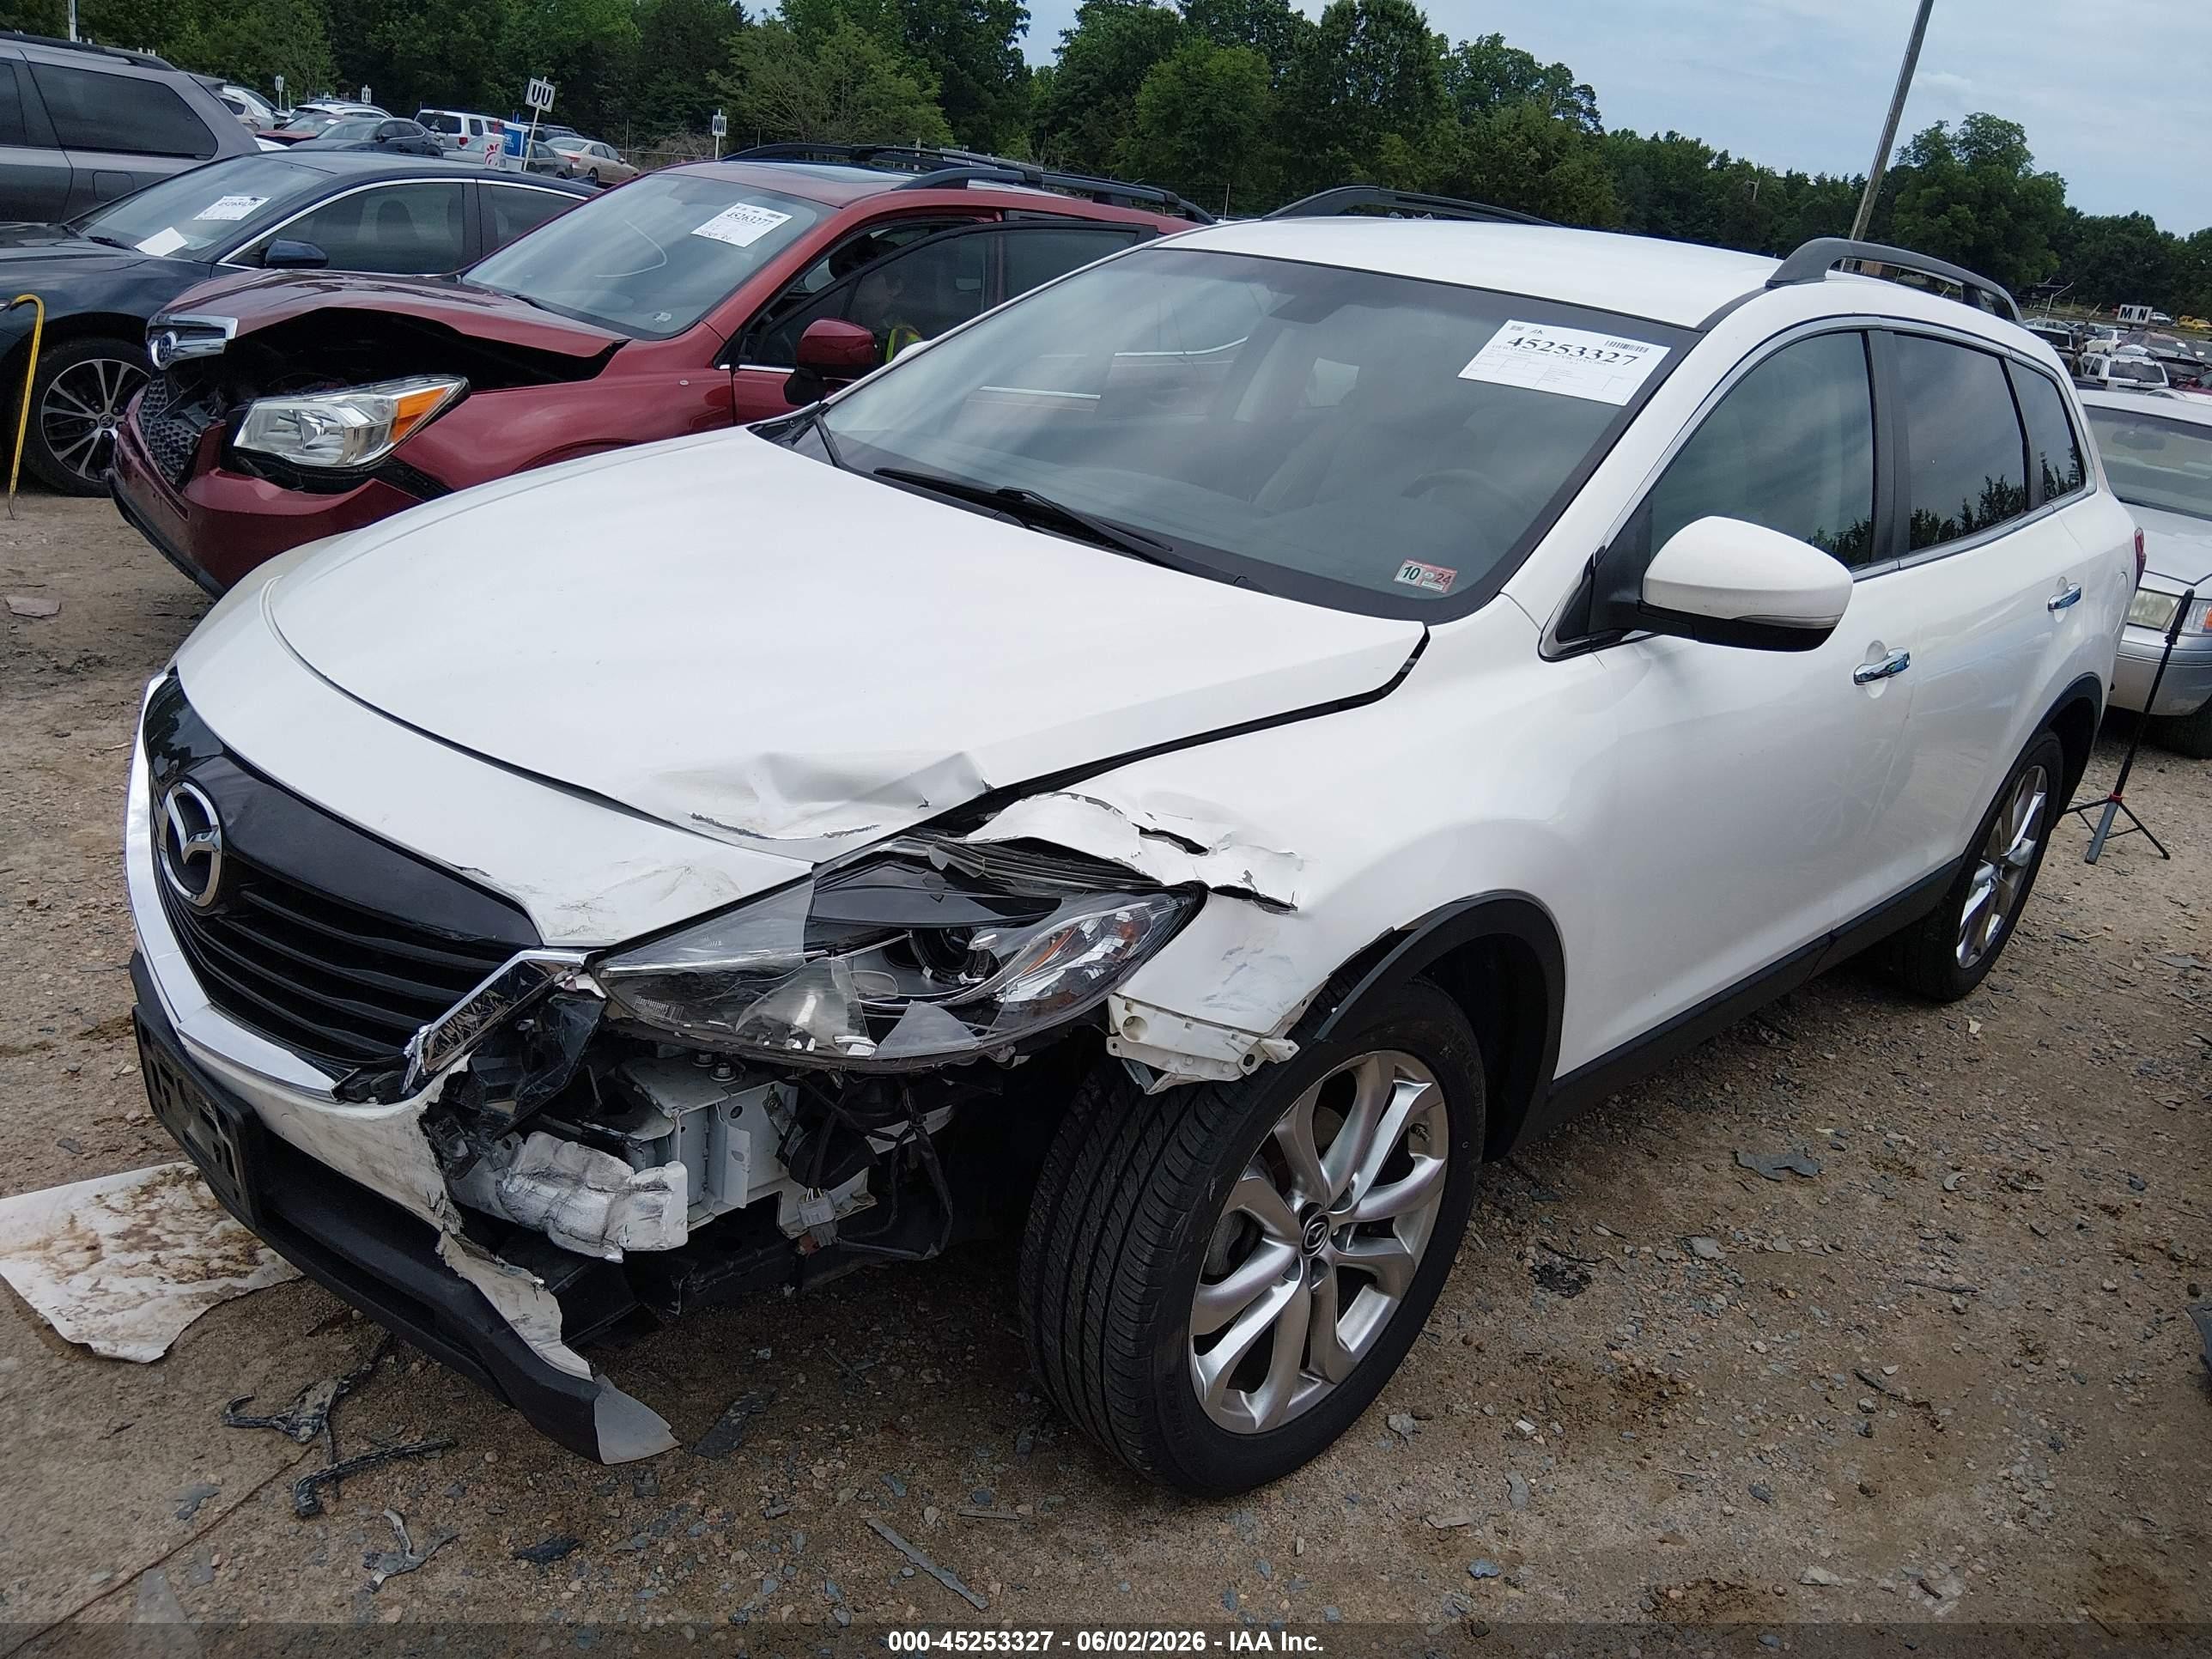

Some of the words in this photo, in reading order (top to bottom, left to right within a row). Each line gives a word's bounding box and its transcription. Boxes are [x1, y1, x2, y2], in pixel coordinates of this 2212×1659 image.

[532, 84, 552, 106] UU
[1507, 337, 1639, 366] 45253327
[1402, 565, 1421, 580] 10
